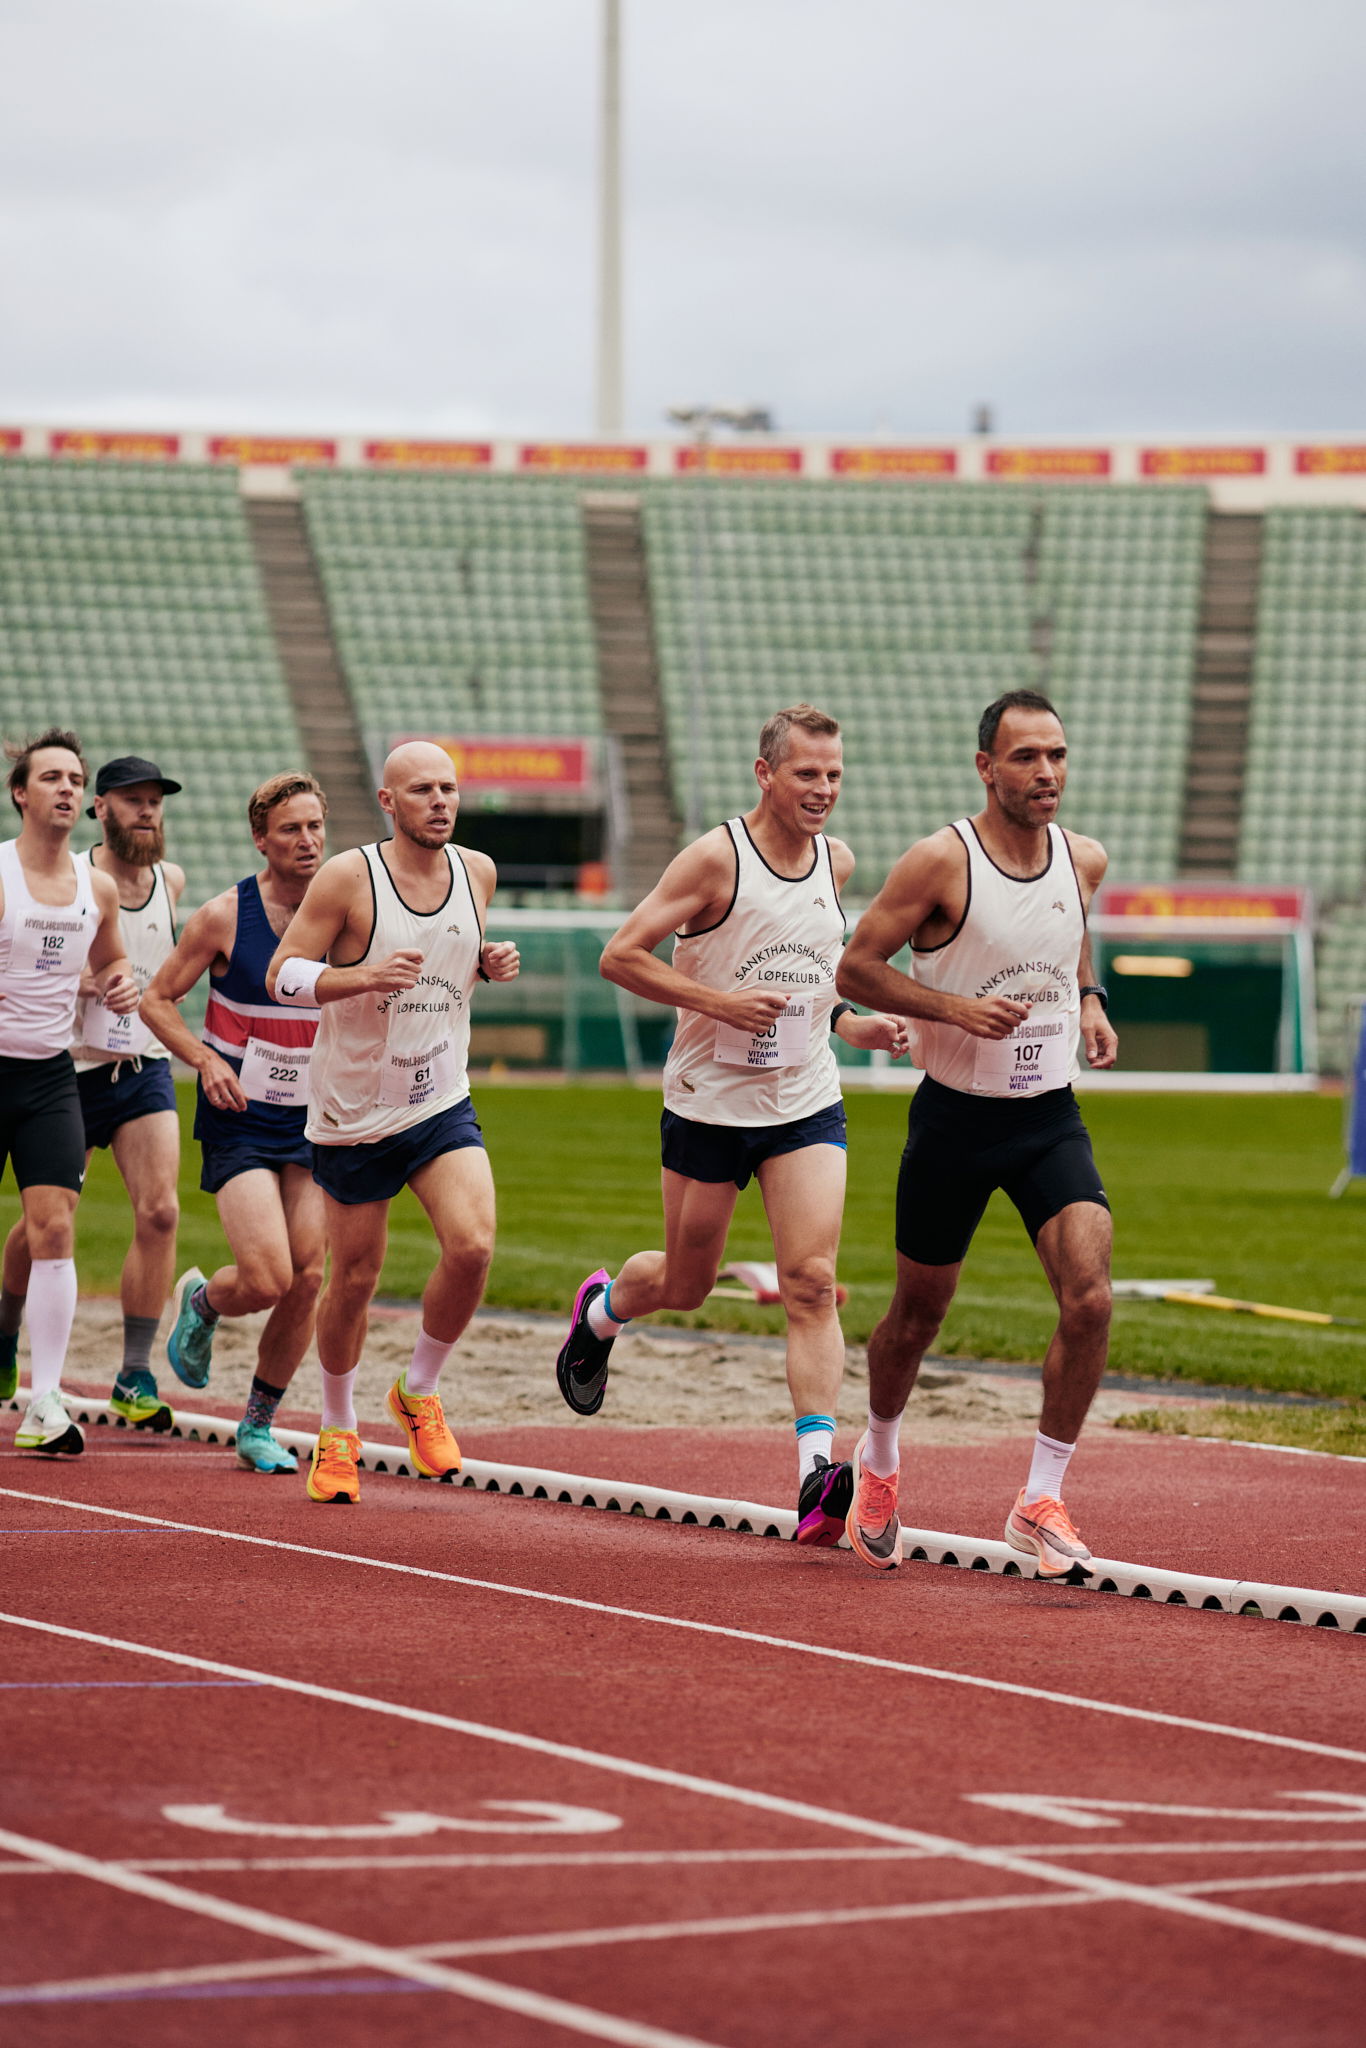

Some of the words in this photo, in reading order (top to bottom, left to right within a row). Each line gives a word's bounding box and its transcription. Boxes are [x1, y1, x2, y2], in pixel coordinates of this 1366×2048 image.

[42, 936, 65, 949] 182
[758, 970, 820, 984] LØPEKLUBB
[397, 1002, 450, 1014] LØPEKLUBB
[117, 1015, 131, 1029] 76
[751, 1038, 778, 1050] Trygve
[748, 1050, 779, 1058] VITAMIN
[1014, 1044, 1043, 1062] 107
[747, 1057, 768, 1066] WELL
[1015, 1062, 1039, 1071] Frode
[269, 1066, 298, 1082] 222
[414, 1066, 430, 1083] 61
[1009, 1074, 1043, 1083] VITAMIN
[1009, 1082, 1029, 1090] WELL
[264, 1095, 282, 1103] WELL
[265, 1089, 295, 1098] VITAMIN
[409, 1086, 435, 1100] VITAMIN
[408, 1097, 426, 1105] WELL
